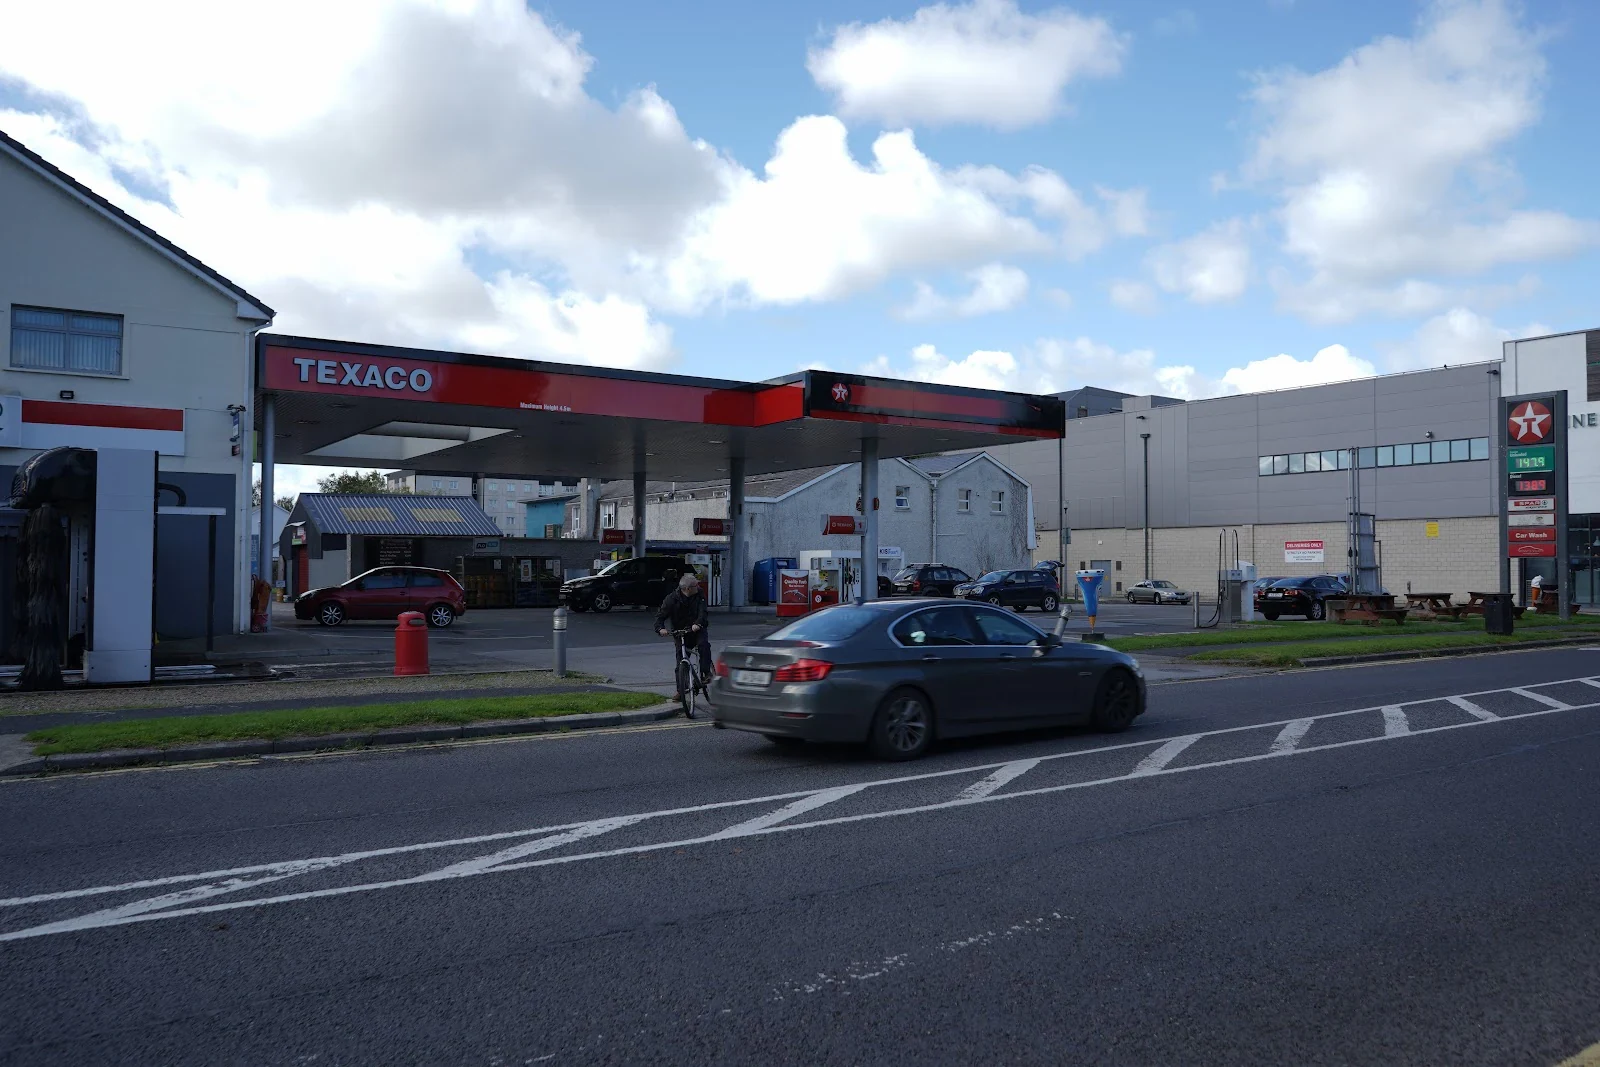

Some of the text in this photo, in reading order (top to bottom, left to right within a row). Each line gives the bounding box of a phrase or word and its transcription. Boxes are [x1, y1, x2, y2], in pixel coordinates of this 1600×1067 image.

[293, 357, 433, 392] TEXACO
[520, 401, 542, 410] Maximum
[543, 403, 559, 411] Height
[1568, 413, 1596, 429] NE
